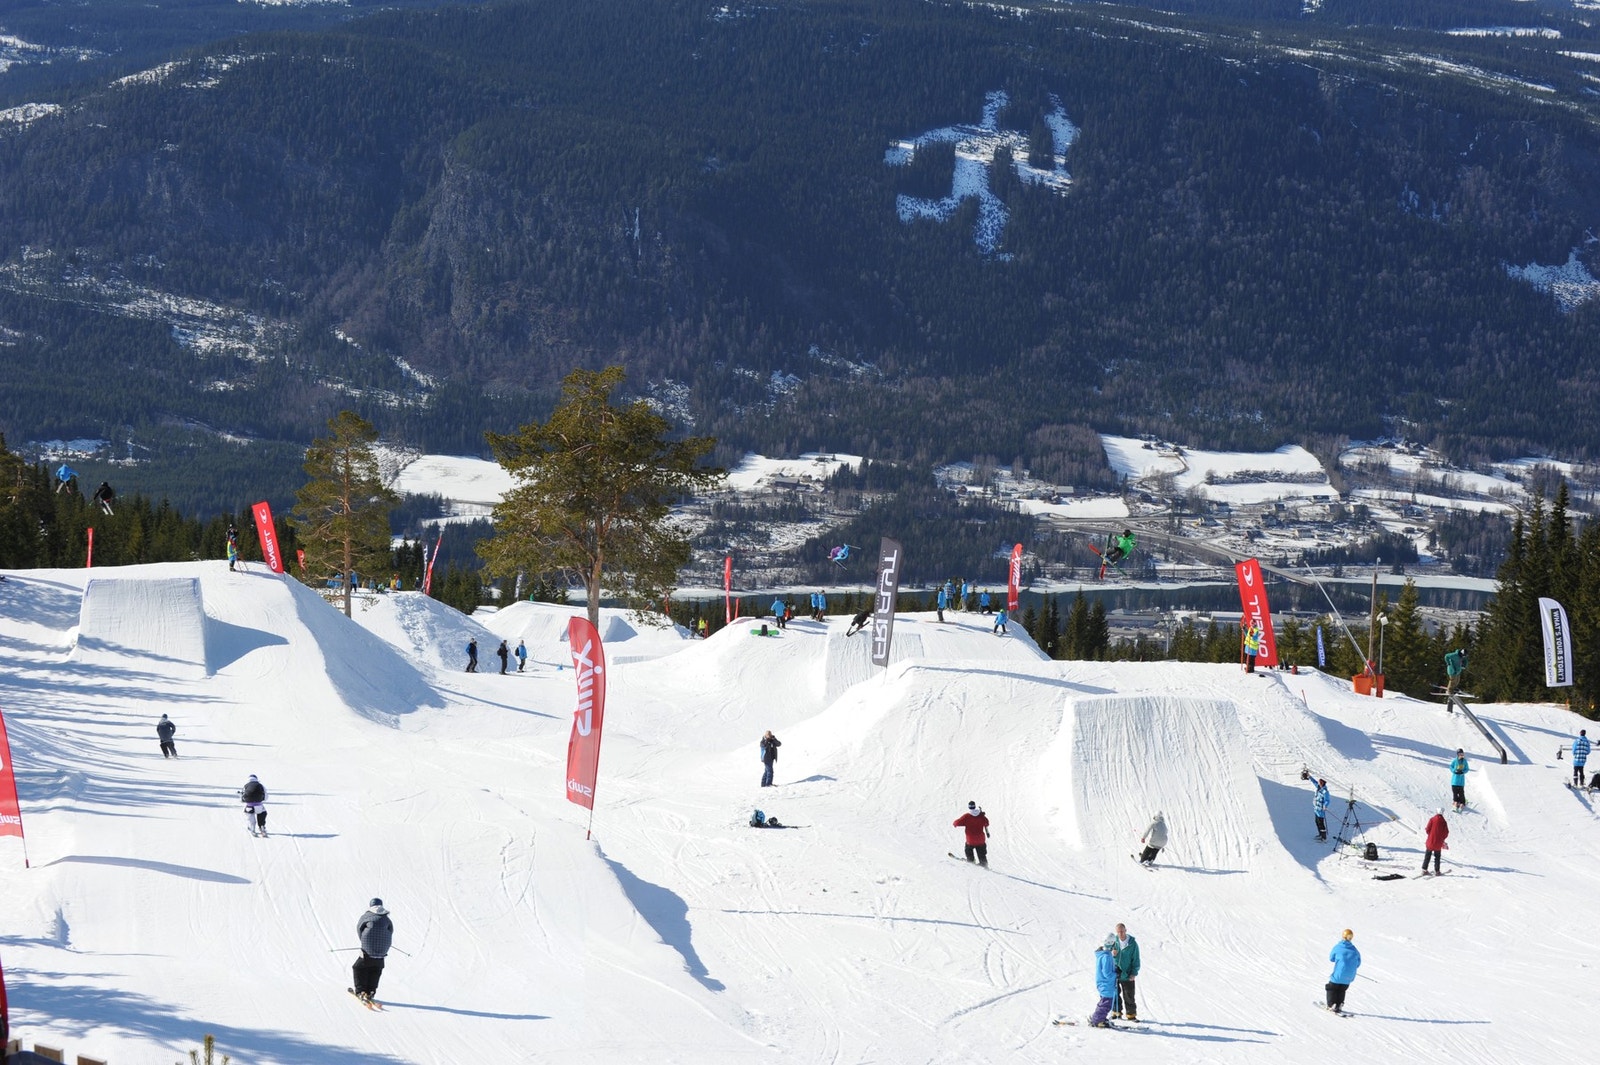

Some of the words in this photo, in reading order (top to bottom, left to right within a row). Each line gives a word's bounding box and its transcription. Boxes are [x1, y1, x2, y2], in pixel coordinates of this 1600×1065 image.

[1553, 610, 1562, 636] WHAT'S
[1556, 636, 1564, 655] YOUR
[1557, 655, 1565, 681] STORY?
